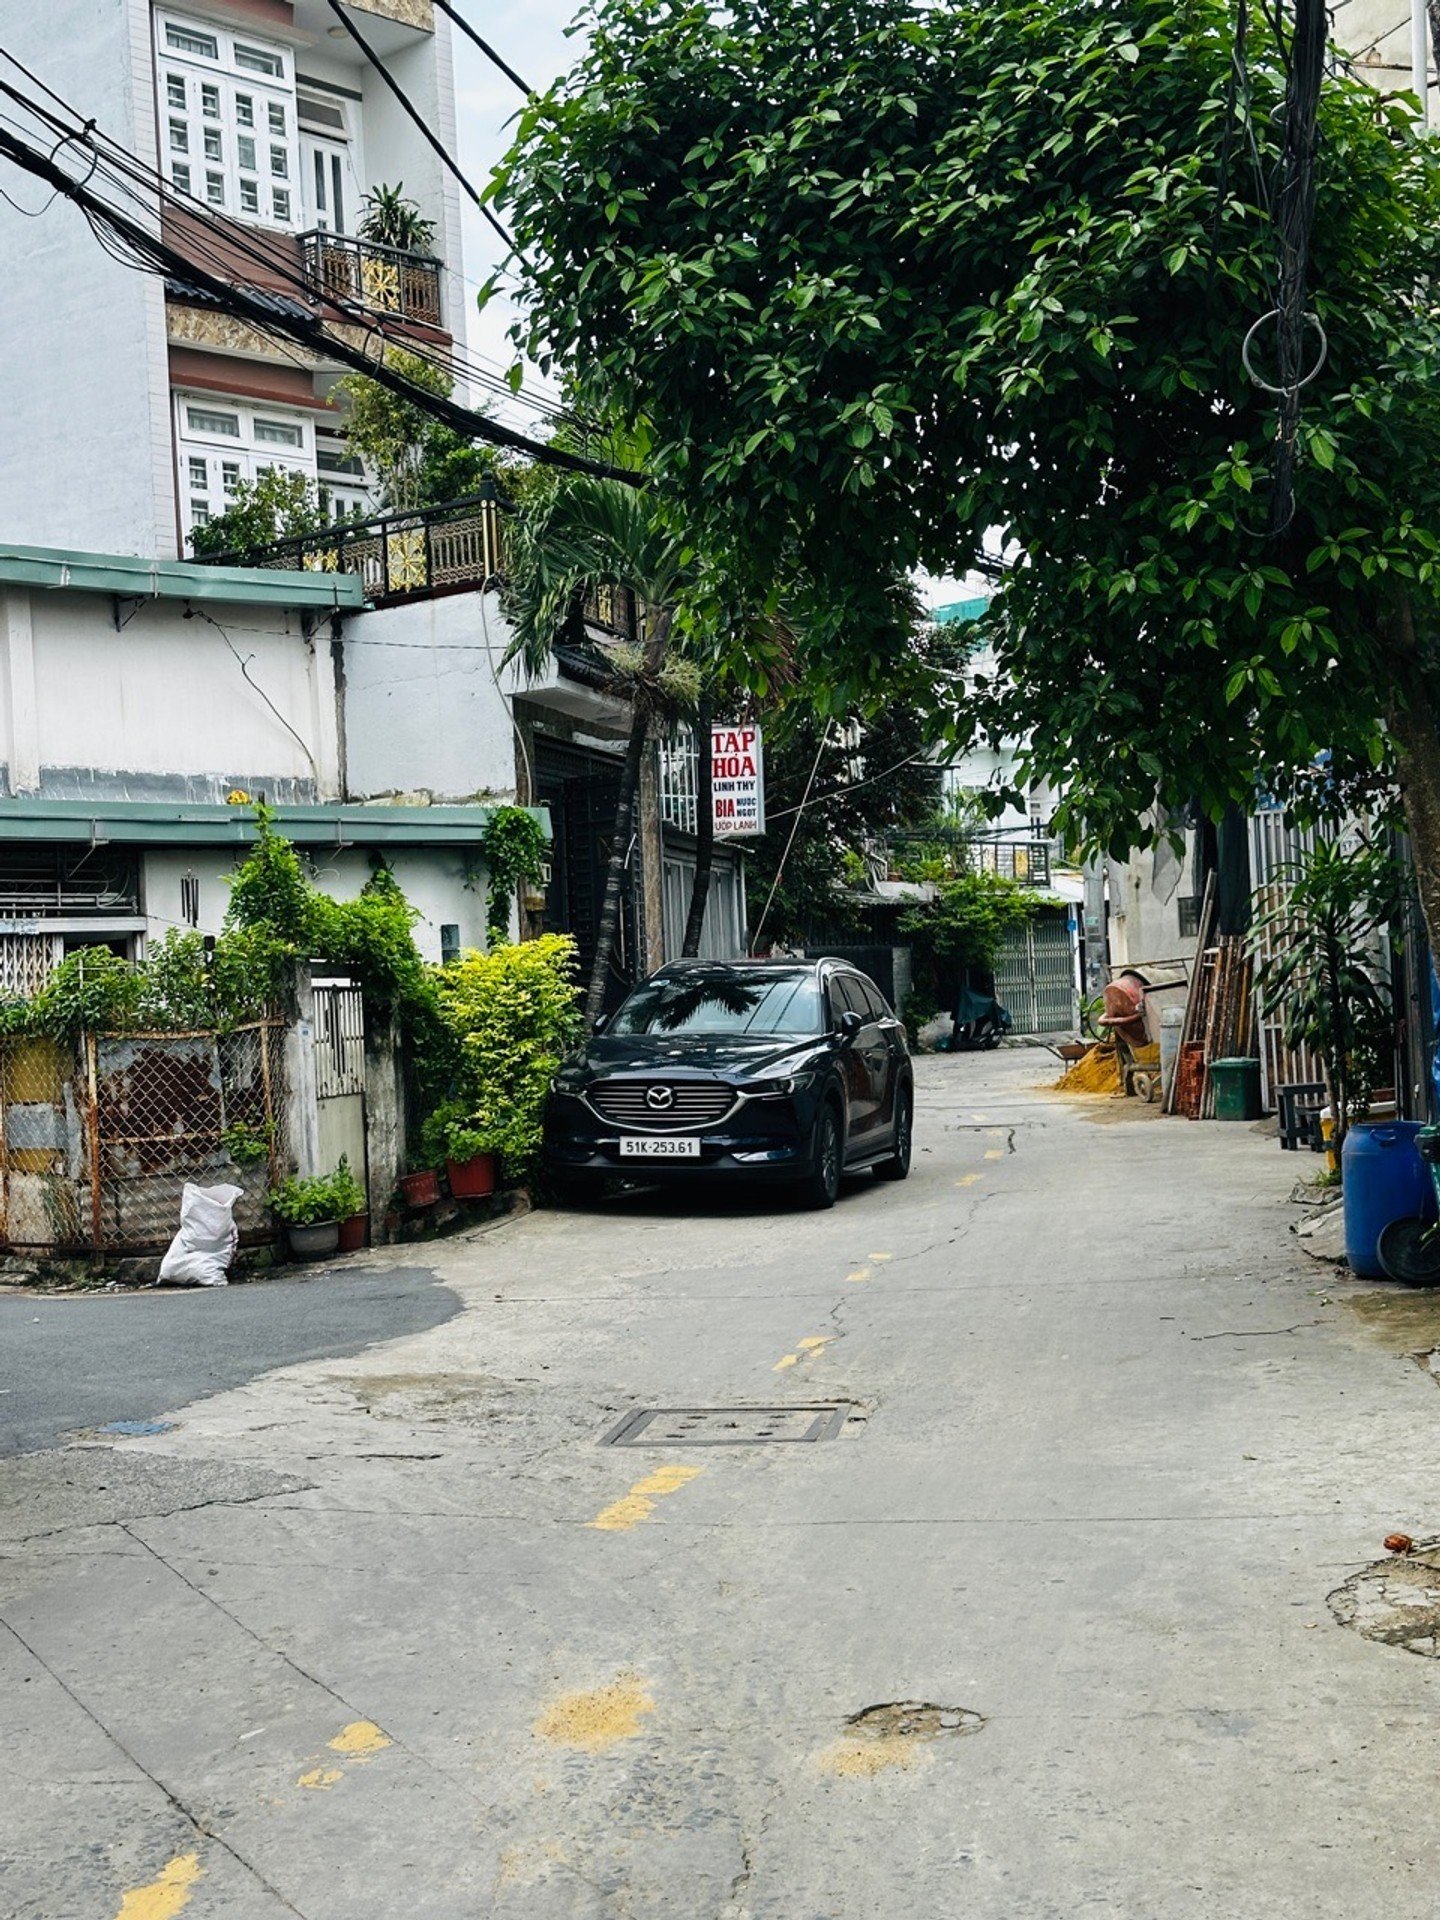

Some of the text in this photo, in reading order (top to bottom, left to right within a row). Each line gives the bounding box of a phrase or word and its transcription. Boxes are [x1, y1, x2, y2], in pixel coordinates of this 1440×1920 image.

[713, 780, 756, 793] LINH THY
[715, 798, 735, 818] BIA
[626, 1141, 693, 1154] 51K-253.61
